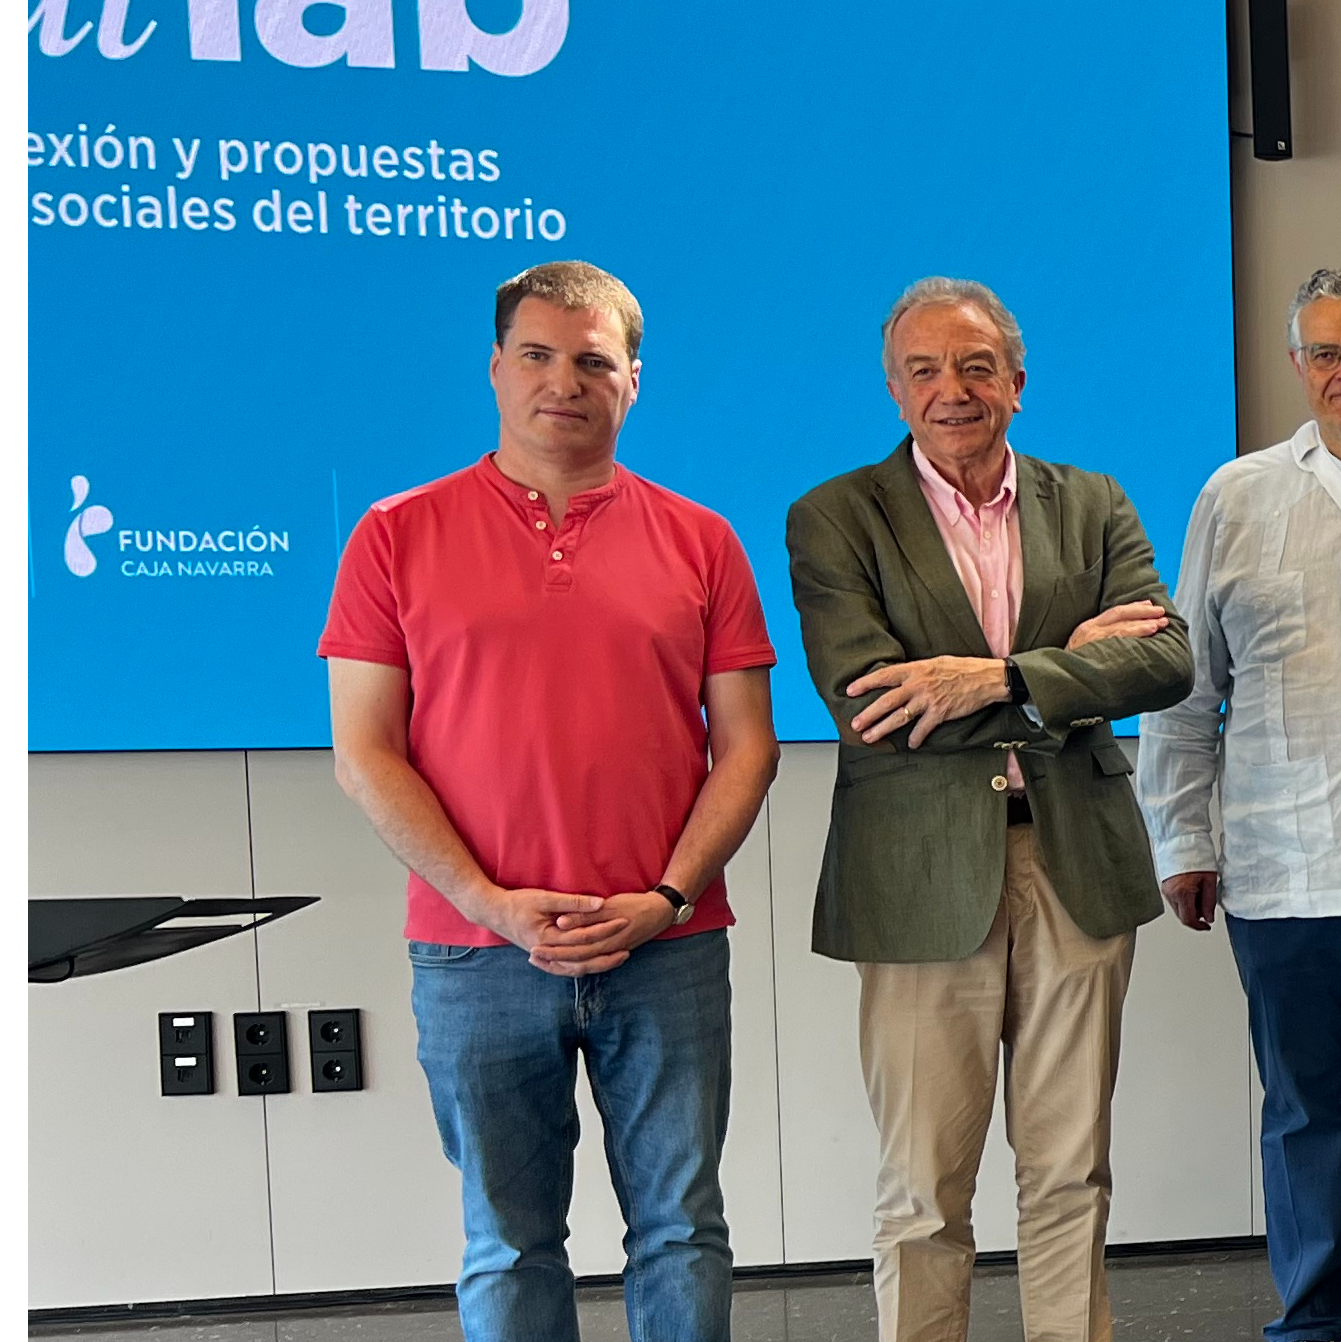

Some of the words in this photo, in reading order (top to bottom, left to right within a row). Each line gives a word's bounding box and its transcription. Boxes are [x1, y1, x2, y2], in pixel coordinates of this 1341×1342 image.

[28, 123, 156, 170] exión
[173, 138, 201, 180] y
[219, 139, 501, 183] propuestas
[32, 185, 237, 232] sociales
[252, 189, 328, 234] del
[344, 194, 567, 241] territorio
[118, 524, 290, 552] FUNDACIÓN
[121, 560, 173, 577] CAJA
[177, 560, 274, 577] NAVARRA
